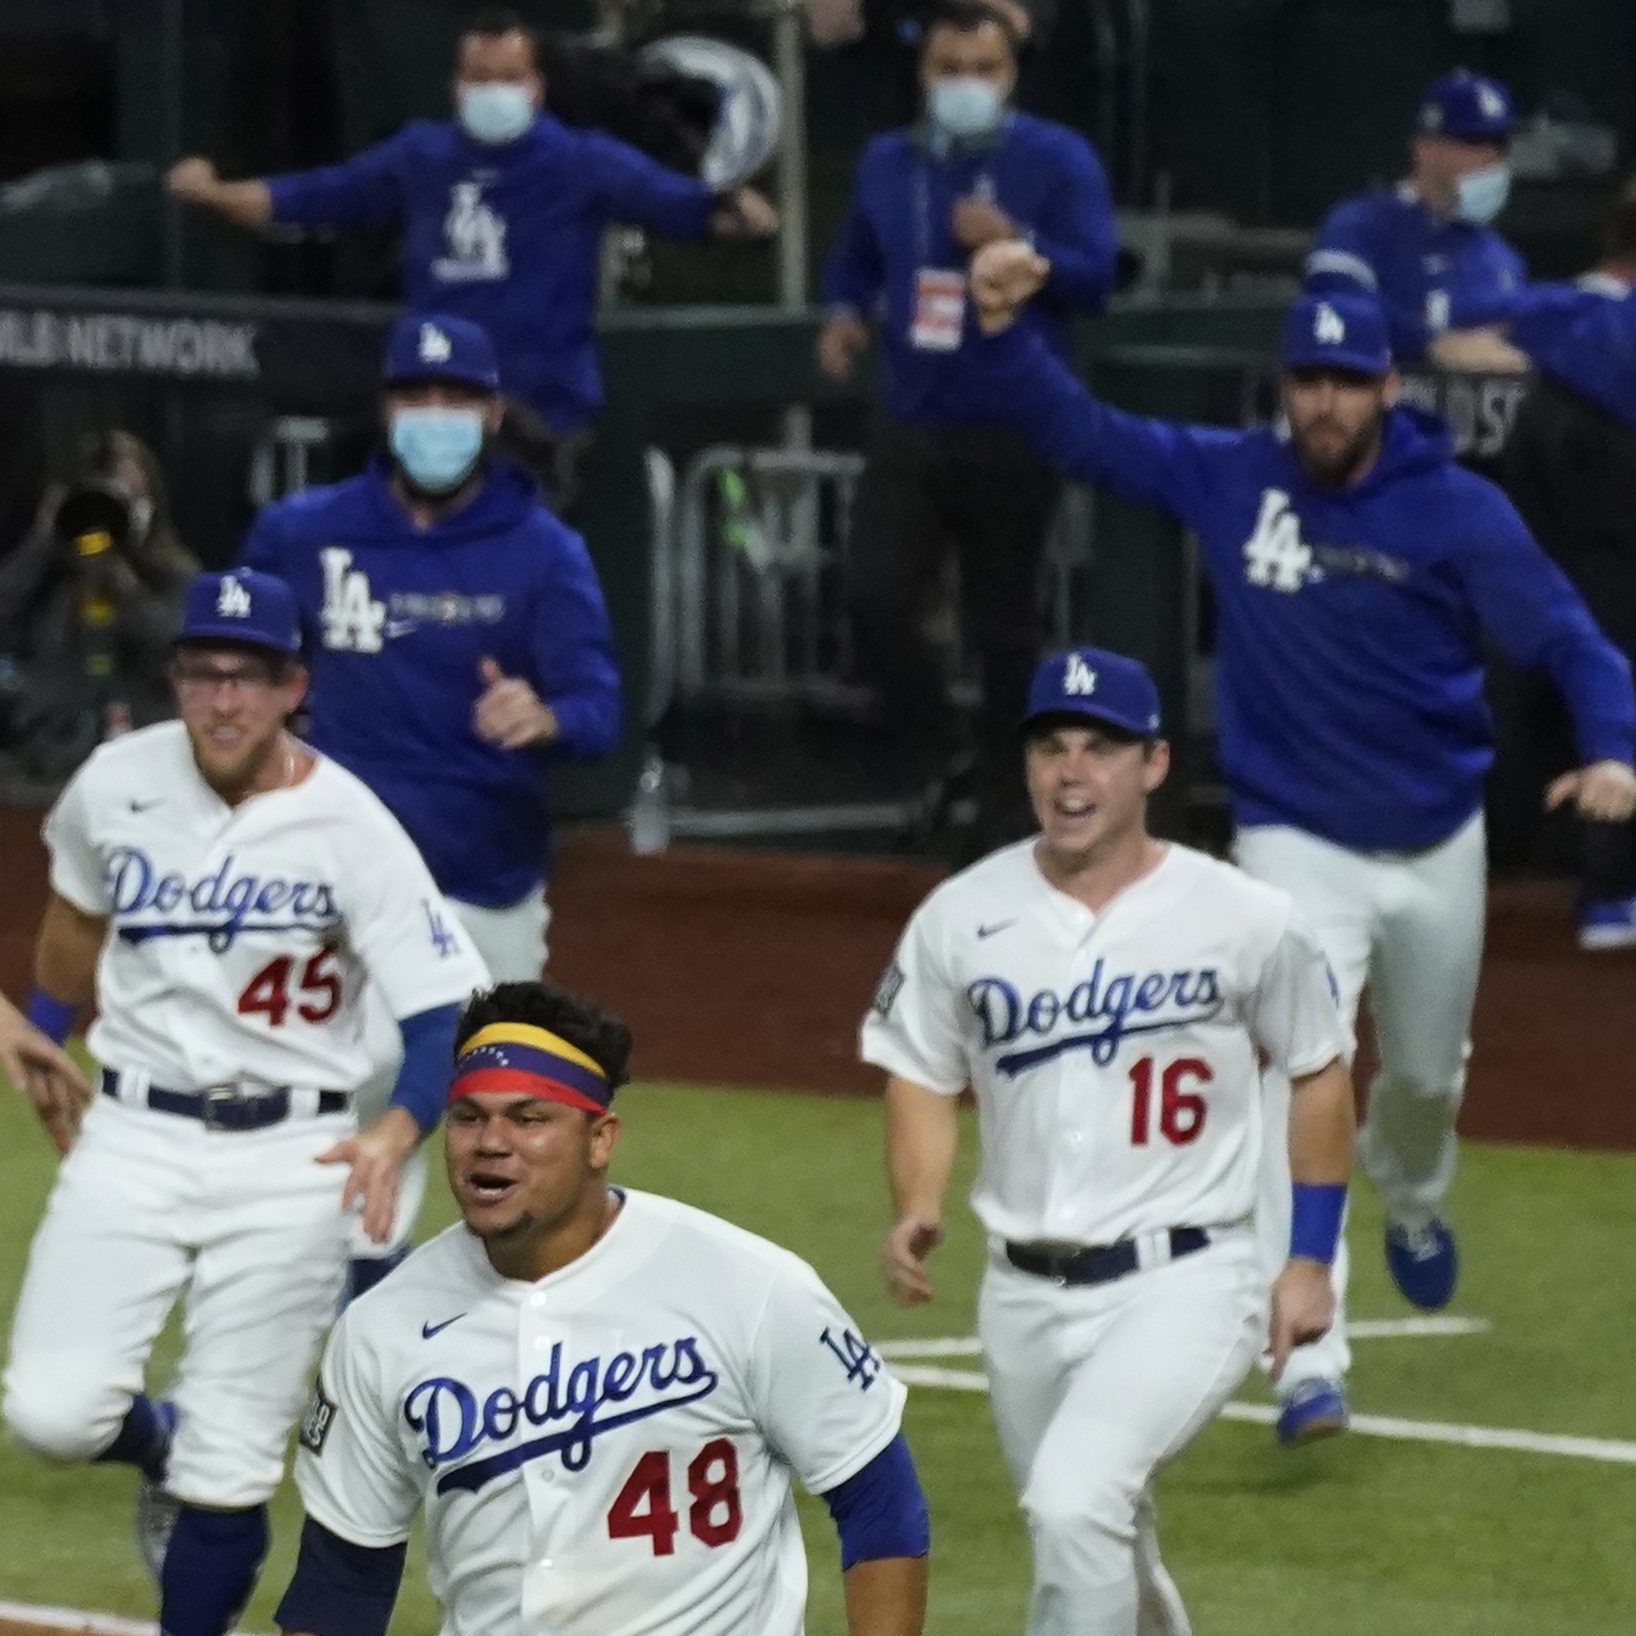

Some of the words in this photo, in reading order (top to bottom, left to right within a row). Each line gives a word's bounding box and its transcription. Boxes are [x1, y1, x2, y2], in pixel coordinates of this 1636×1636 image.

[320, 548, 386, 652] LA
[107, 845, 341, 953] Dodgers
[236, 947, 342, 1027] 45
[966, 959, 1225, 1073] Dodgers
[1128, 1057, 1215, 1147] 16
[820, 1326, 880, 1392] LA
[404, 1335, 719, 1495] Dodgers
[607, 1436, 744, 1557] 48
